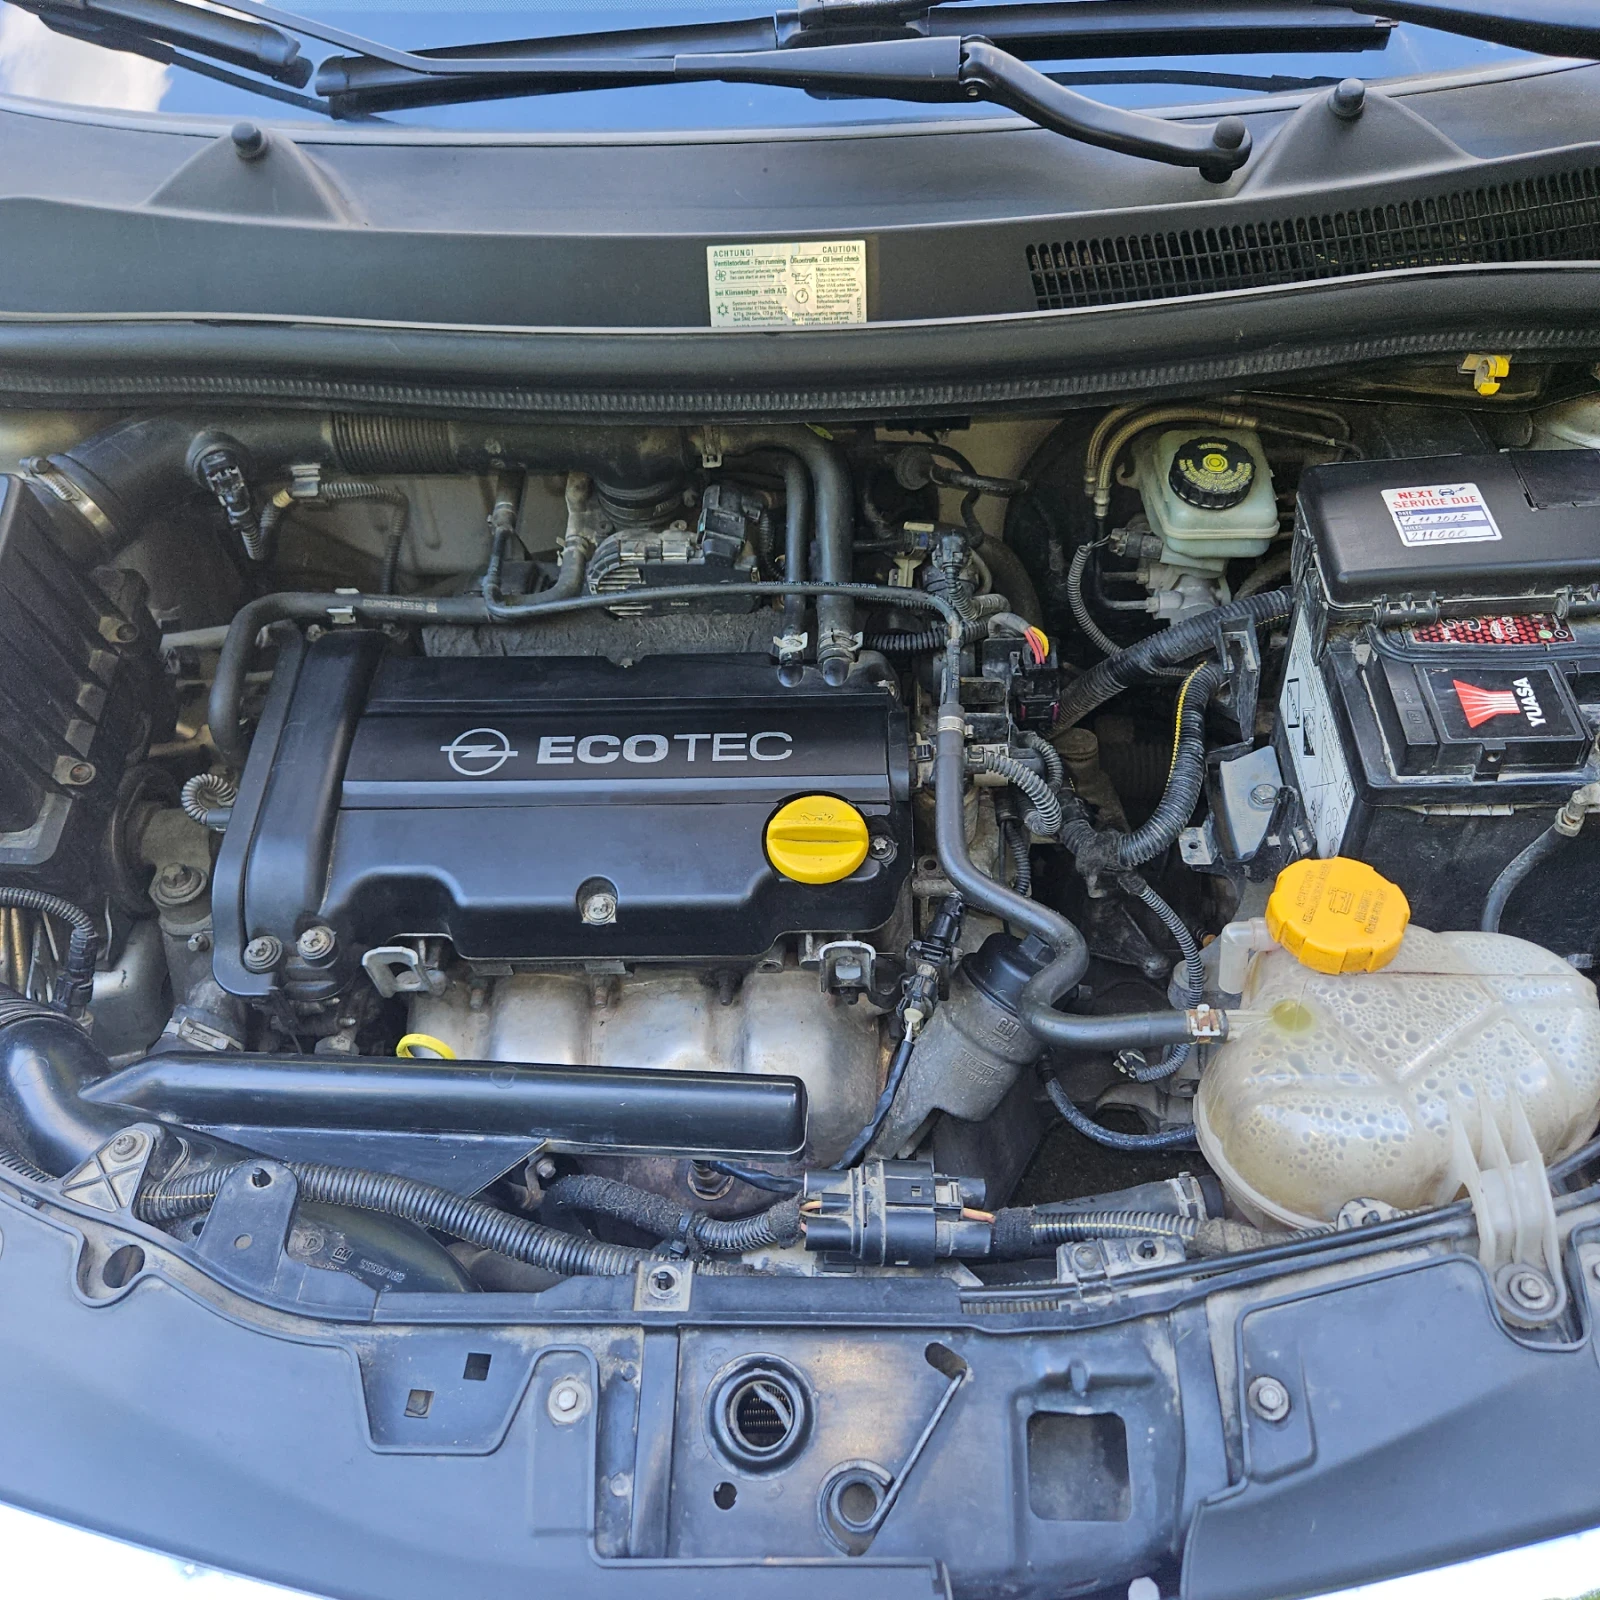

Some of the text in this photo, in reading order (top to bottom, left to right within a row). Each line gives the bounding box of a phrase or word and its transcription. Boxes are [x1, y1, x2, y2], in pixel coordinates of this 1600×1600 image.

[713, 249, 754, 258] ACHTUNG!
[1393, 496, 1478, 508] SERVICE DUE
[1397, 490, 1432, 499] NEXT
[1502, 615, 1519, 640] YBX3
[1512, 677, 1546, 727] YUASA
[536, 731, 793, 764] ECOTEC
[996, 1018, 1020, 1038] GM
[334, 1247, 353, 1260] GM
